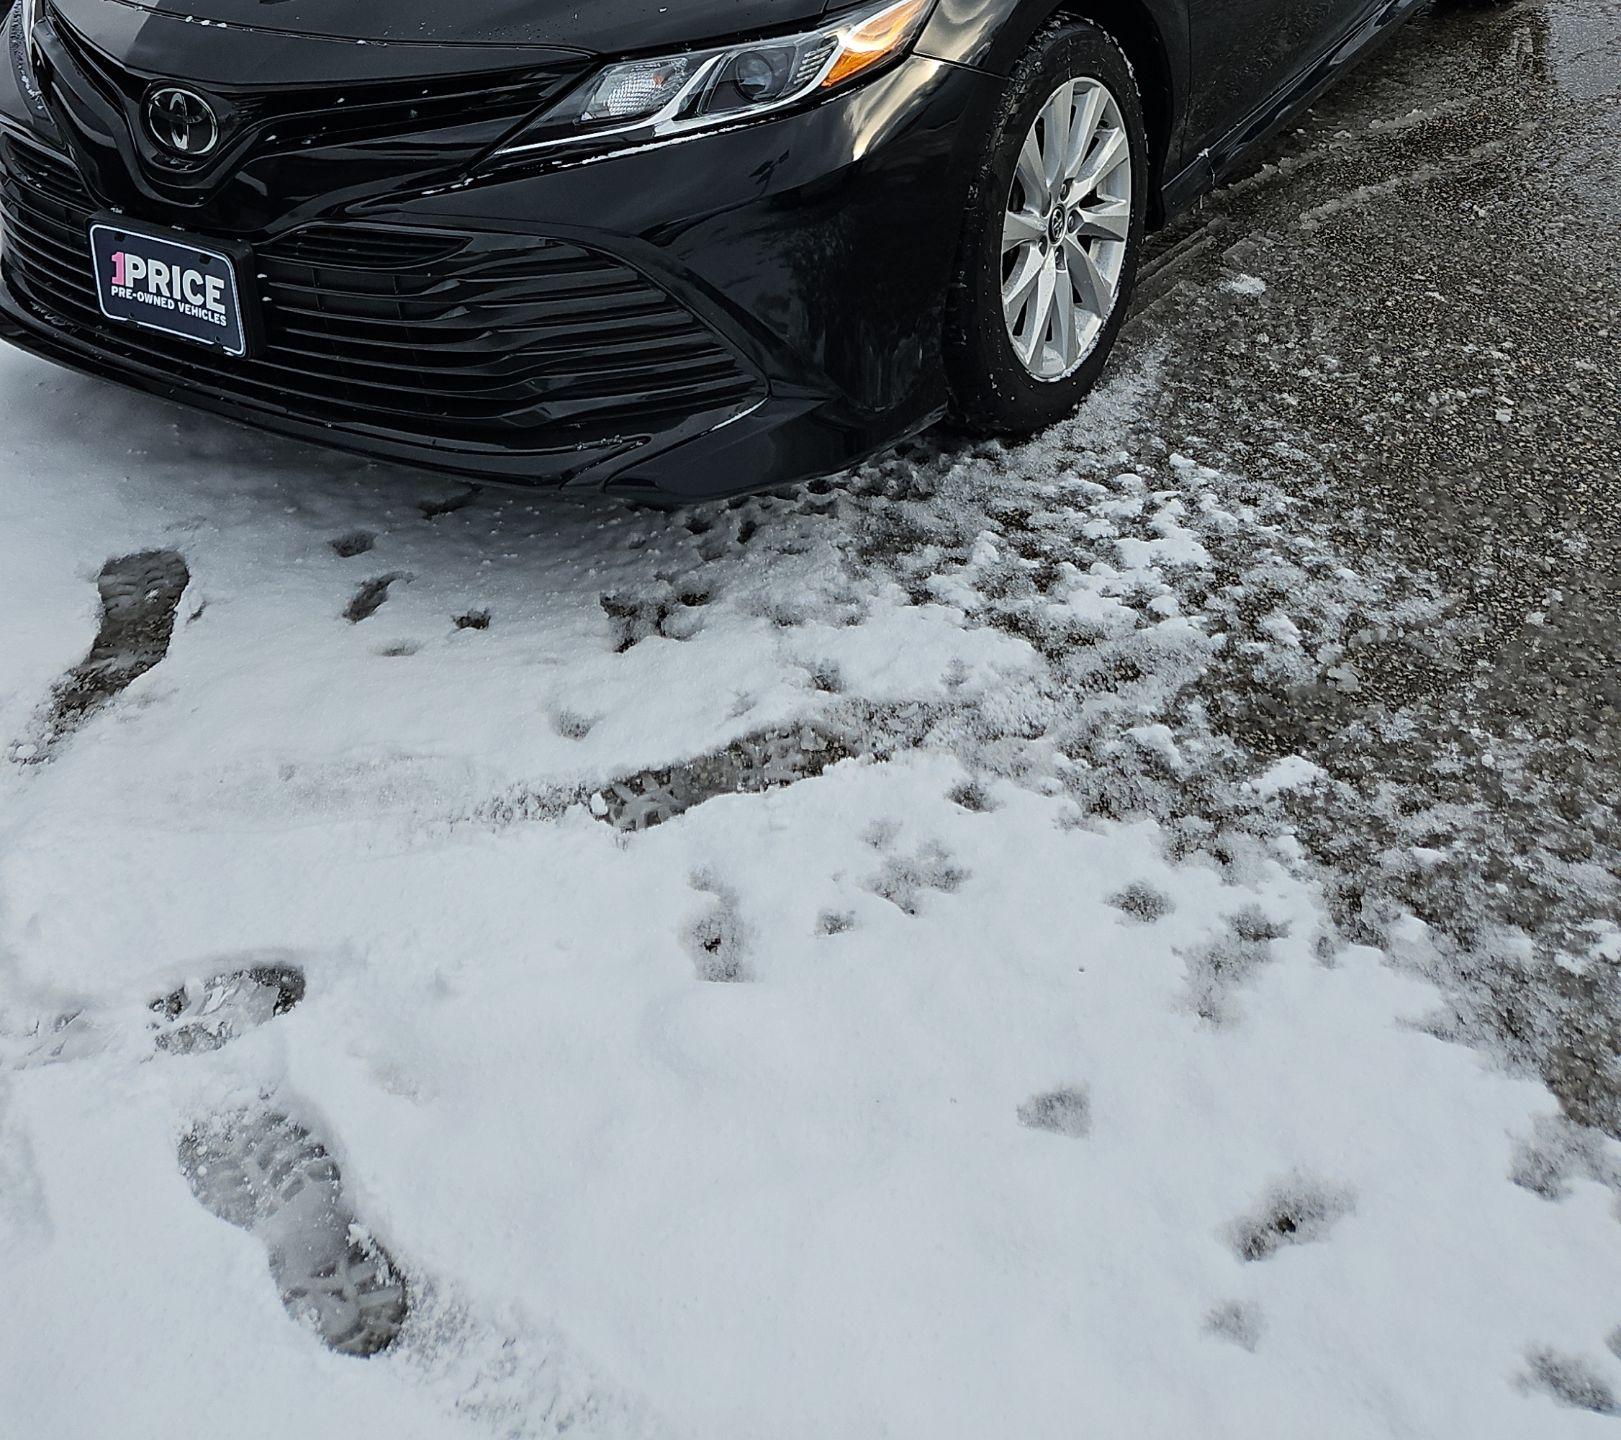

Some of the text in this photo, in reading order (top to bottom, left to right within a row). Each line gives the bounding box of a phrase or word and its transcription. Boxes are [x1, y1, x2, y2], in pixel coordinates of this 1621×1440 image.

[111, 251, 226, 315] 1PRICE
[111, 285, 227, 327] PRE-OWNED VEHICLES
